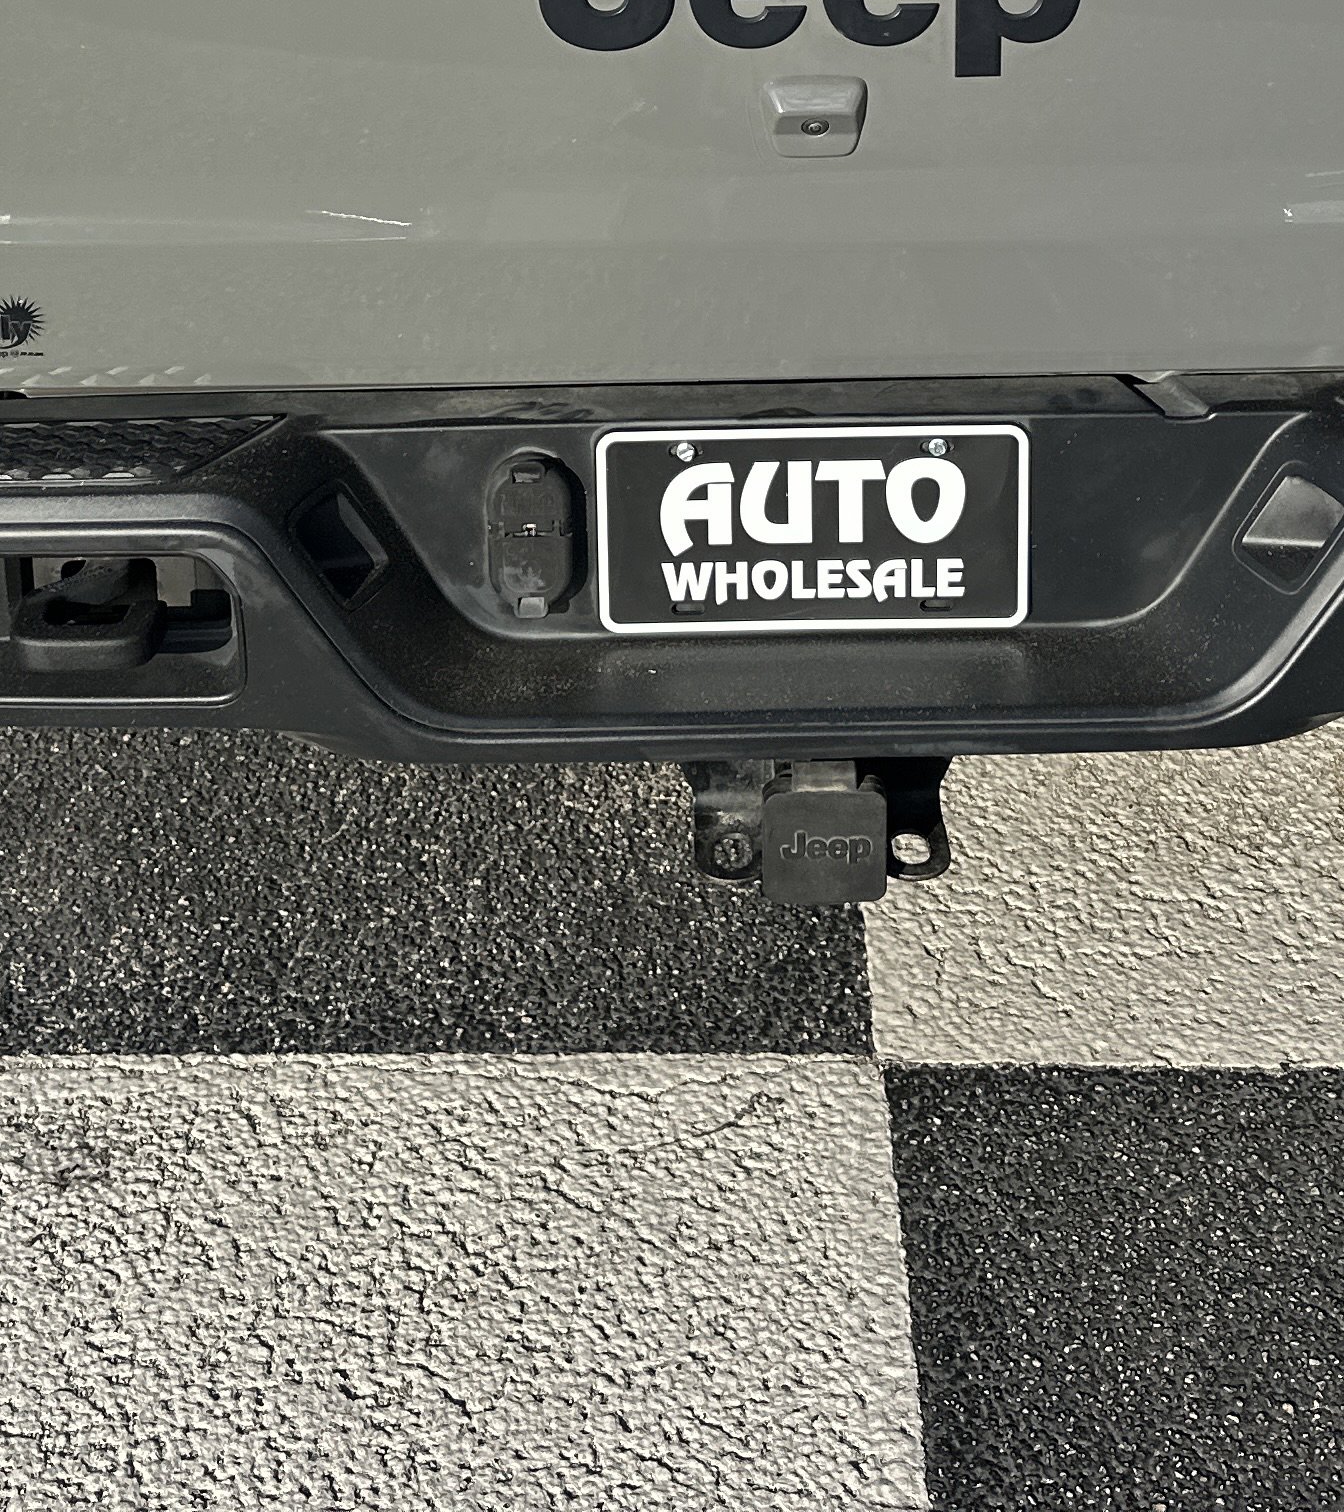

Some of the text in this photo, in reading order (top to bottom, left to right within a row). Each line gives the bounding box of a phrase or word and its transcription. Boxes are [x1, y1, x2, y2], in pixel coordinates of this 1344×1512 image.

[659, 457, 966, 557] AUTO
[661, 558, 966, 605] WHOLESALE
[779, 829, 873, 865] Jeep
